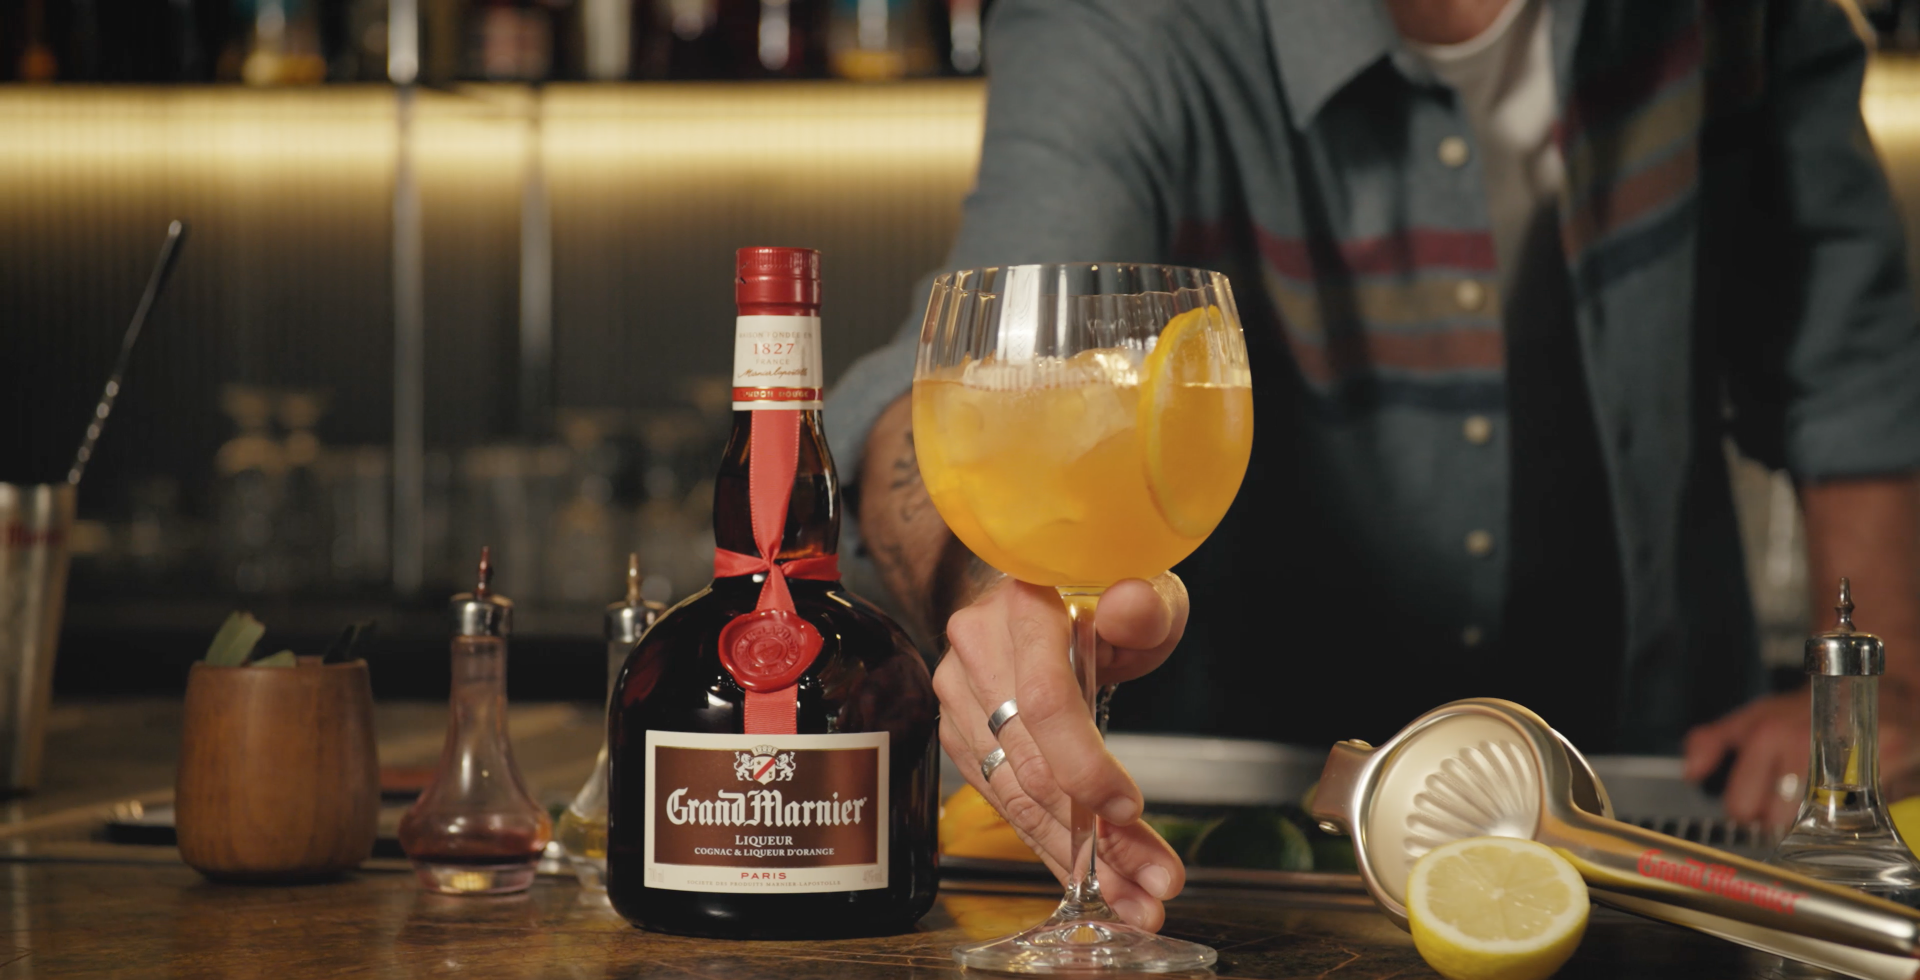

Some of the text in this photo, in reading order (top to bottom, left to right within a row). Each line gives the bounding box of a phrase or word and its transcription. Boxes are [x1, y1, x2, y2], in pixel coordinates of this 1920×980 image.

[753, 342, 795, 355] 1827
[666, 787, 866, 828] Grand Marnier
[735, 834, 794, 848] LIQUEUR
[694, 847, 835, 858] COGNAC & LIQUEUR D'ORANGE
[740, 872, 788, 880] PARIS
[1637, 848, 1809, 915] Grand Marnier
